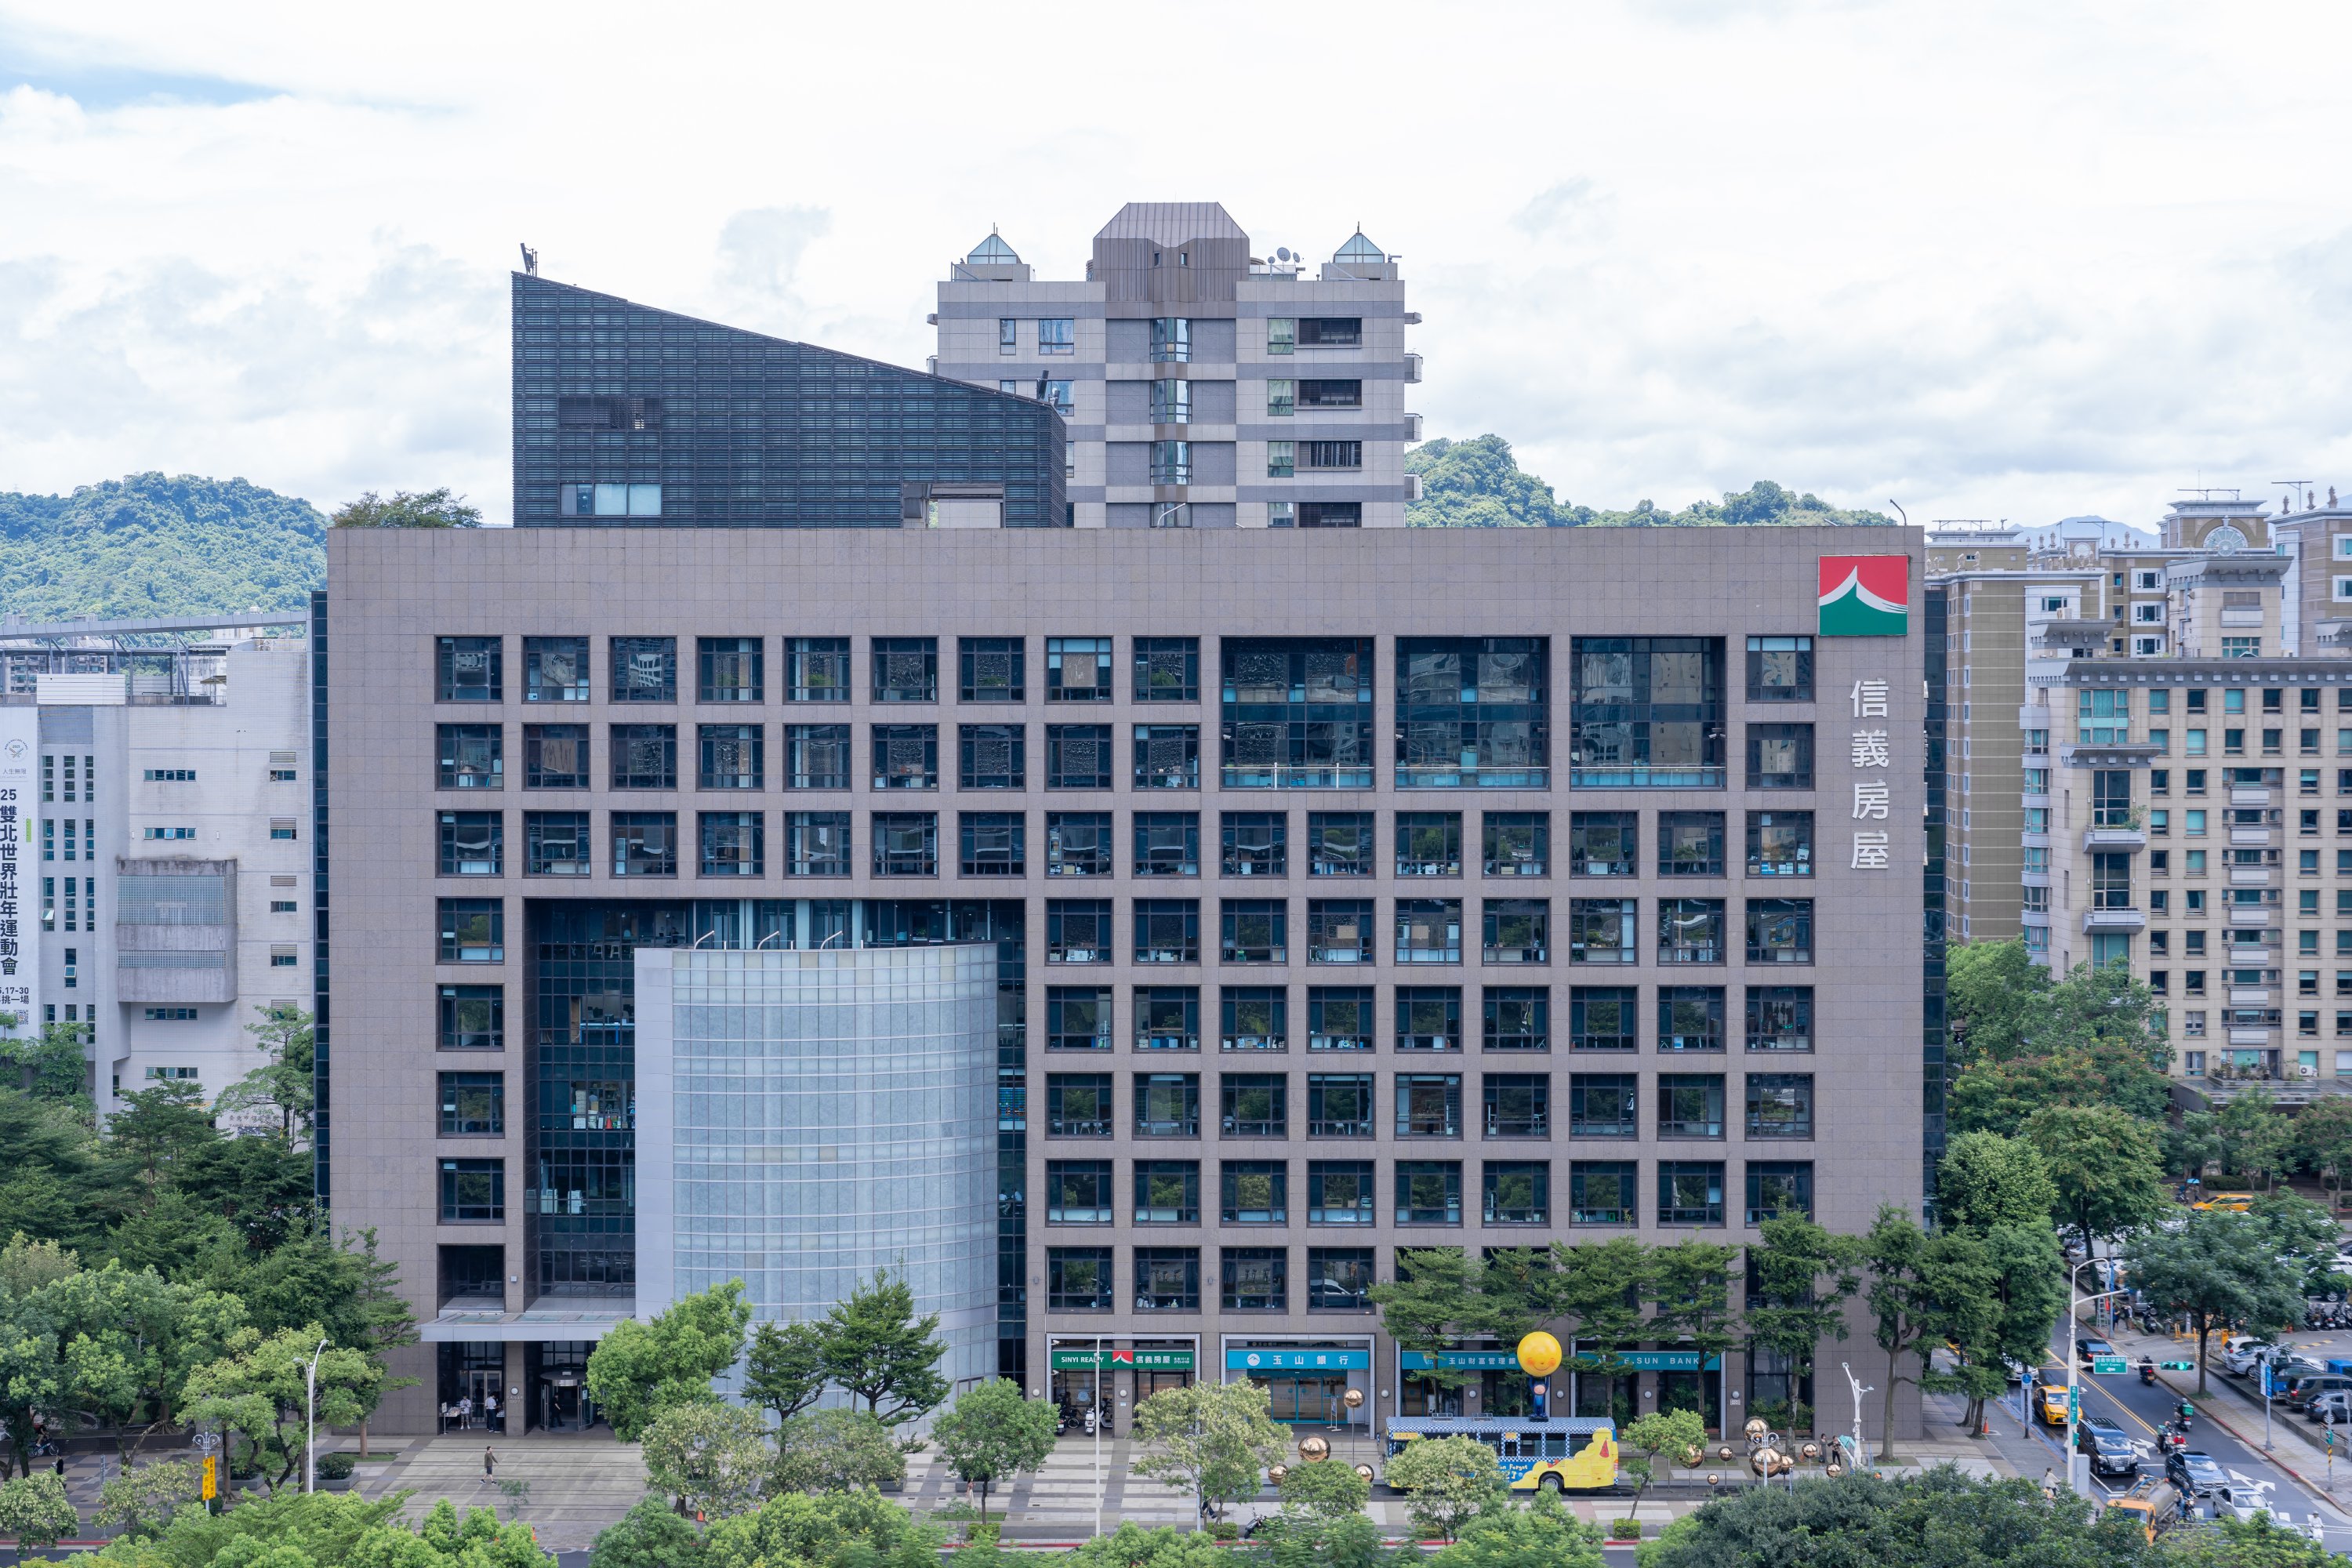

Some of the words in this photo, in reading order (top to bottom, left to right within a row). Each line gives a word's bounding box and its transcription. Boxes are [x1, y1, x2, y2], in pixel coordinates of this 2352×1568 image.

[1849, 679, 1889, 869] 信義房屋
[0, 805, 18, 975] 雙北世界壯年運動會
[0, 995, 29, 1004] 挑一場
[1272, 1355, 1348, 1365] 玉山銀行
[1509, 1463, 1528, 1472] Forgot
